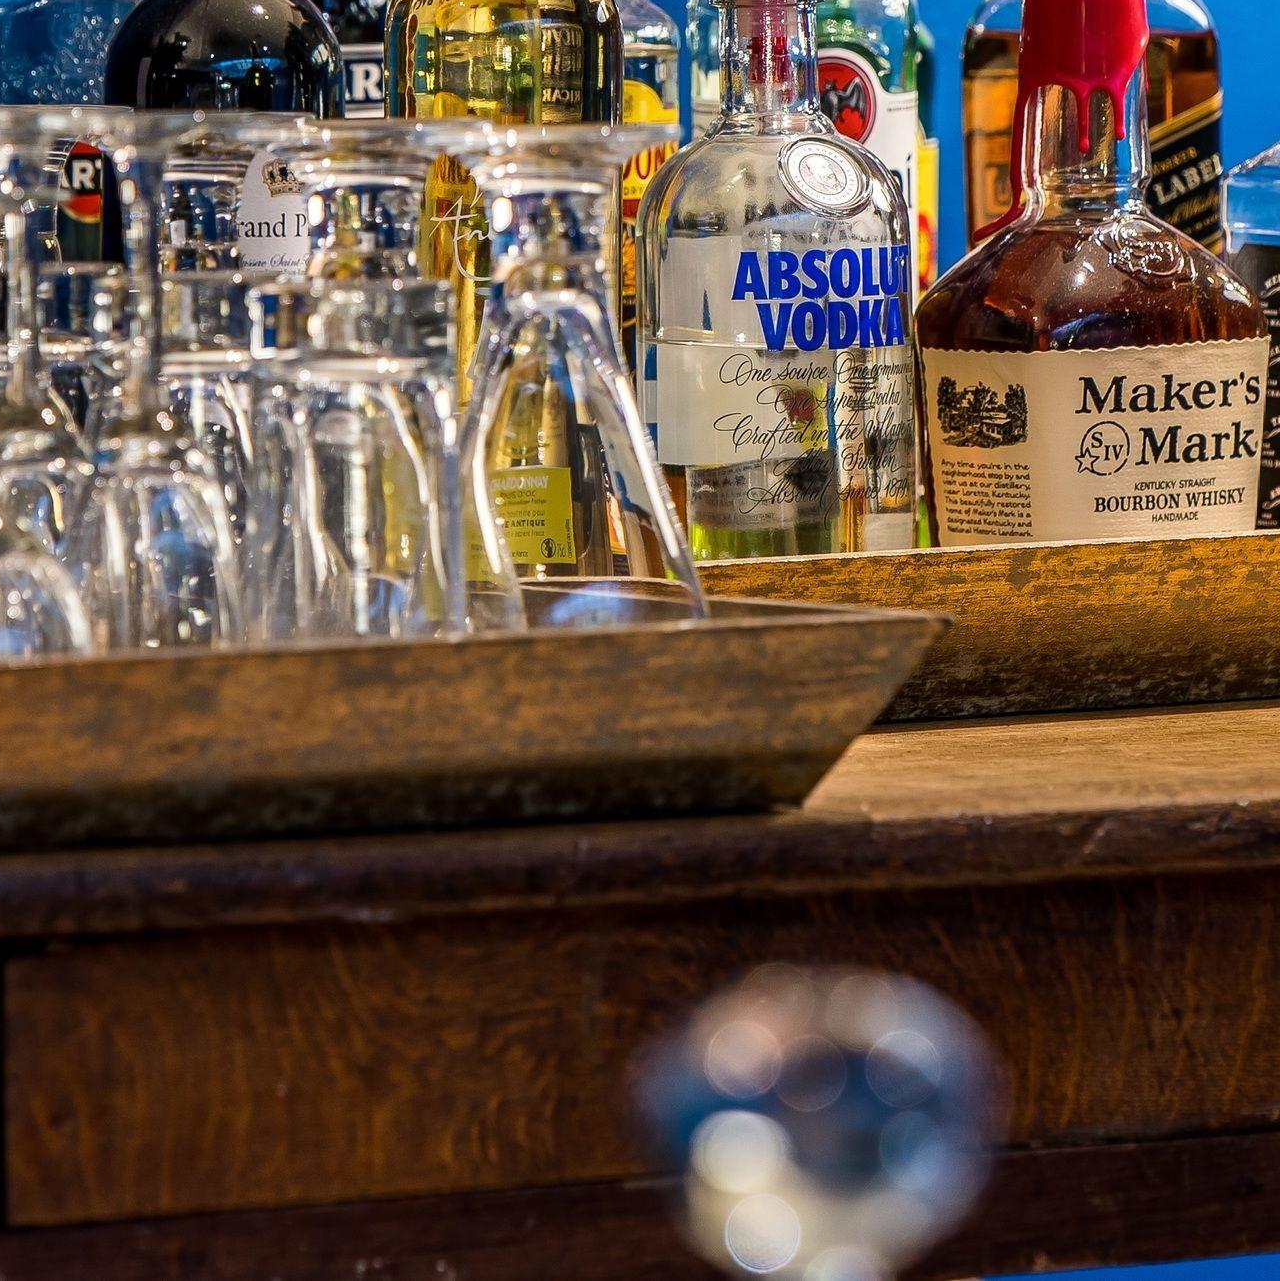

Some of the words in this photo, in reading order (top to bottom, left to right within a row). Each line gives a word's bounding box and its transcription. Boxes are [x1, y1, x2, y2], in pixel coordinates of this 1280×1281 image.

[237, 212, 286, 238] rand
[731, 244, 909, 301] ABSOLUT
[755, 296, 905, 352] VODKA
[719, 353, 772, 386] One
[1075, 371, 1261, 415] Maker's
[713, 411, 810, 460] Crafted
[810, 423, 832, 444] in
[828, 410, 865, 440] the
[1091, 431, 1104, 449] S
[1135, 421, 1258, 466] Mark
[1103, 444, 1125, 461] IV
[941, 458, 956, 469] Any
[956, 460, 975, 469] time
[977, 461, 1003, 471] you're
[1003, 462, 1013, 471] in
[1013, 463, 1030, 471] the
[1004, 471, 1014, 482] by
[1015, 473, 1031, 481] and
[1133, 480, 1177, 492] KENTUCKY
[1178, 477, 1217, 490] STRAIGHT
[996, 501, 1032, 509] restored
[1094, 493, 1181, 513] BOURBON
[1185, 487, 1246, 508] WHISKY
[964, 507, 972, 517] of
[997, 509, 1016, 518] Mark
[1017, 510, 1024, 518] is
[1151, 511, 1200, 523] HANDMADE
[511, 519, 546, 528] ANTIQUE
[1017, 520, 1033, 528] and
